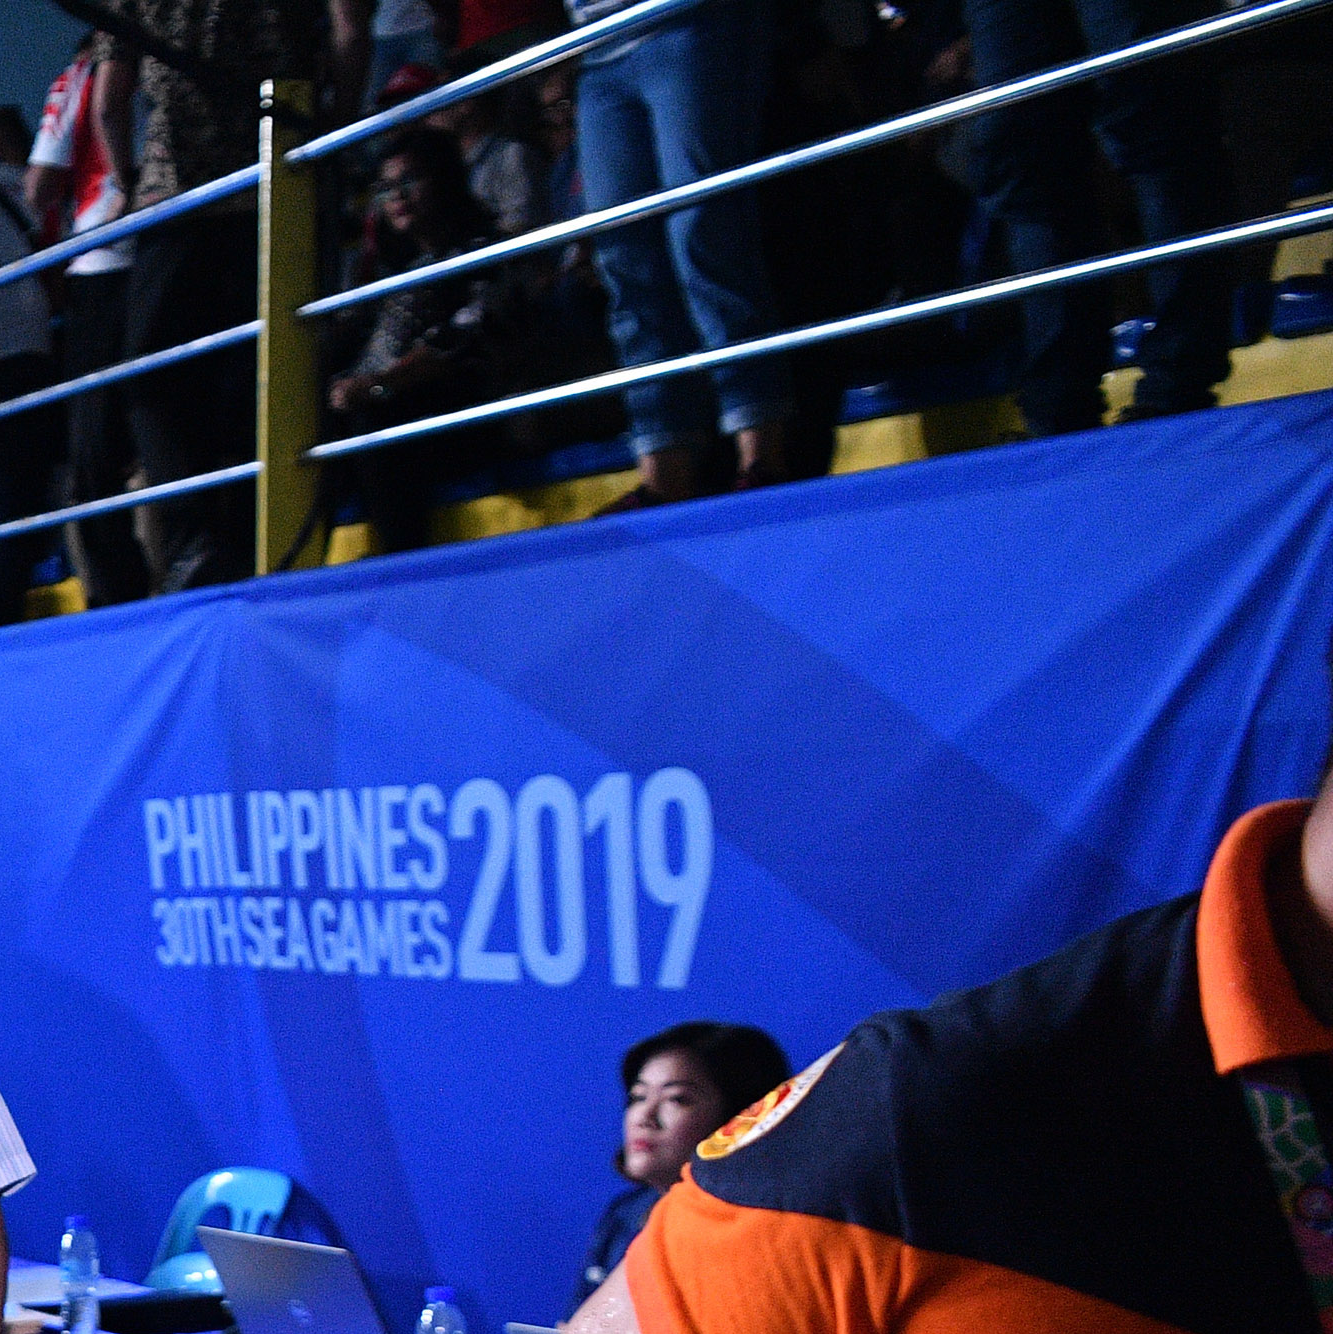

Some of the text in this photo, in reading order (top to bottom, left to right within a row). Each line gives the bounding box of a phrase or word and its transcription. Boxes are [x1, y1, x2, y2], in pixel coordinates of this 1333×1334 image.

[144, 766, 714, 990] PHILIPPINES 2019
[152, 897, 243, 967] 30TH
[309, 899, 453, 979] GAMES
